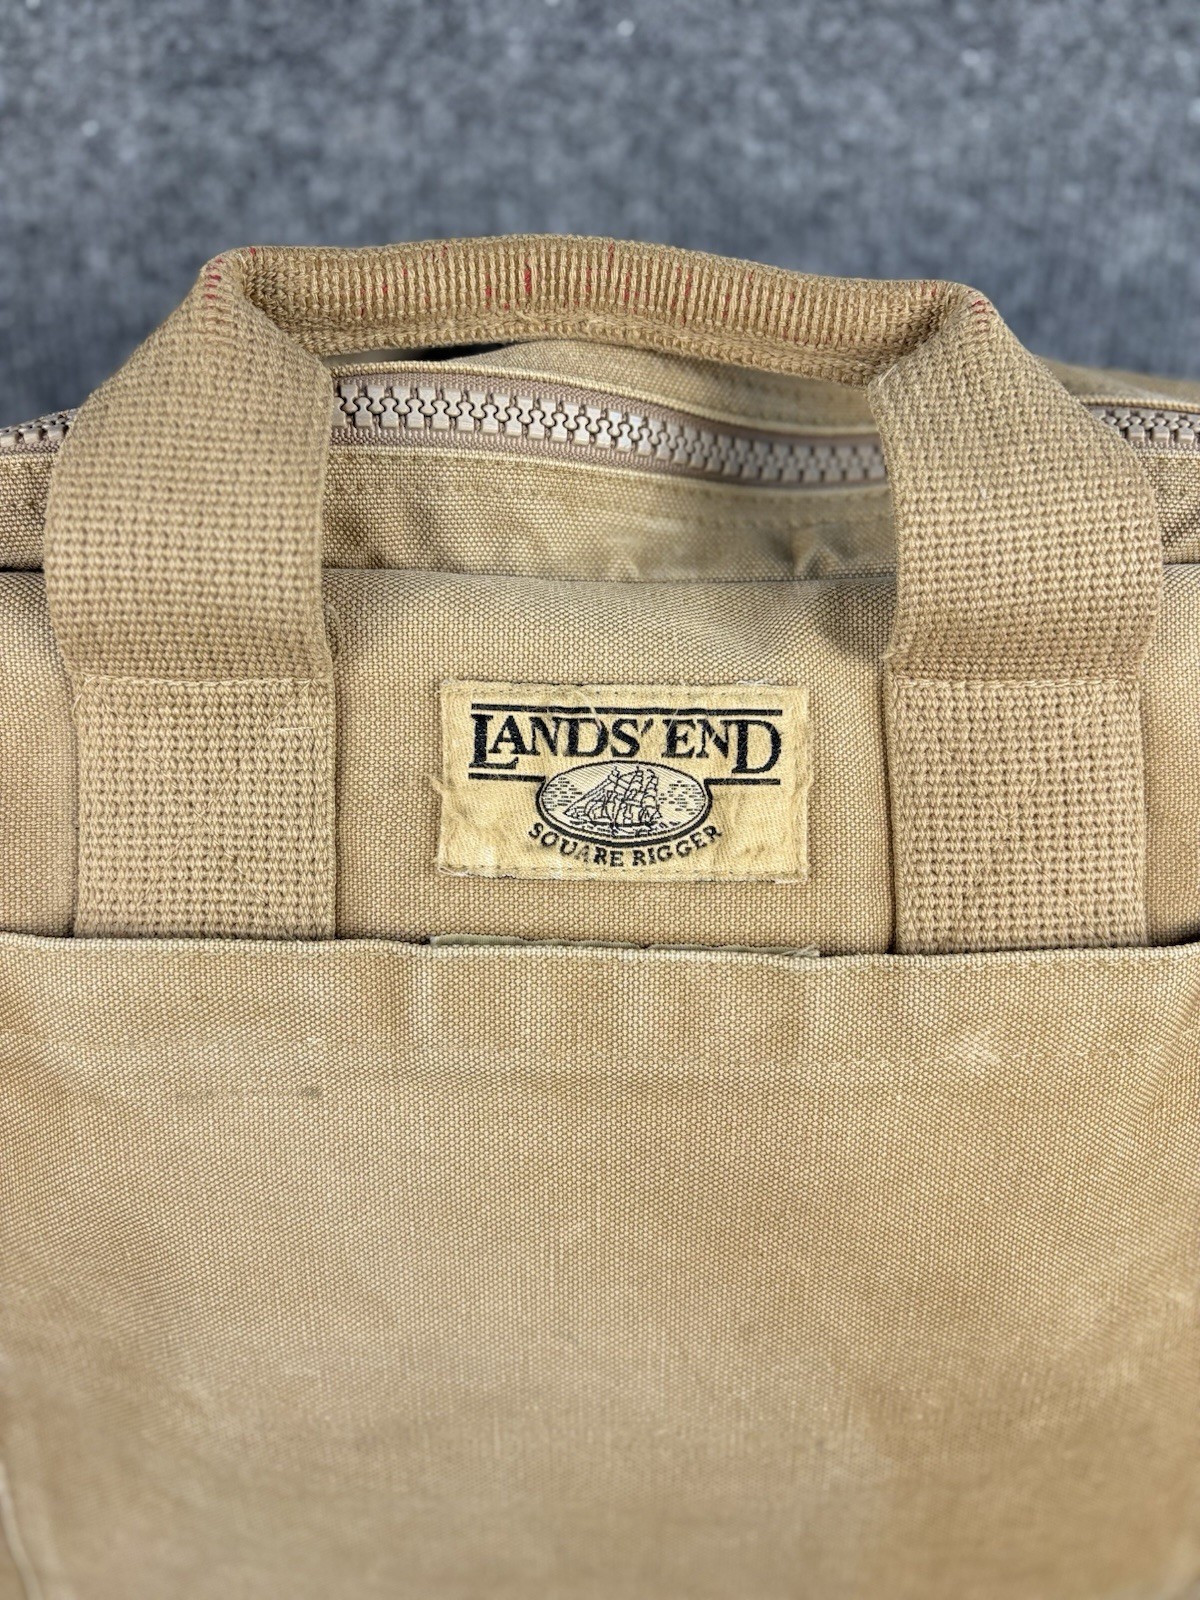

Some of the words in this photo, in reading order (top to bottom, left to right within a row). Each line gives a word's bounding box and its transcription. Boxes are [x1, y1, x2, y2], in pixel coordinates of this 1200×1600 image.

[468, 713, 654, 770] LANDS'
[661, 718, 783, 775] END
[632, 825, 723, 867] RIGGER
